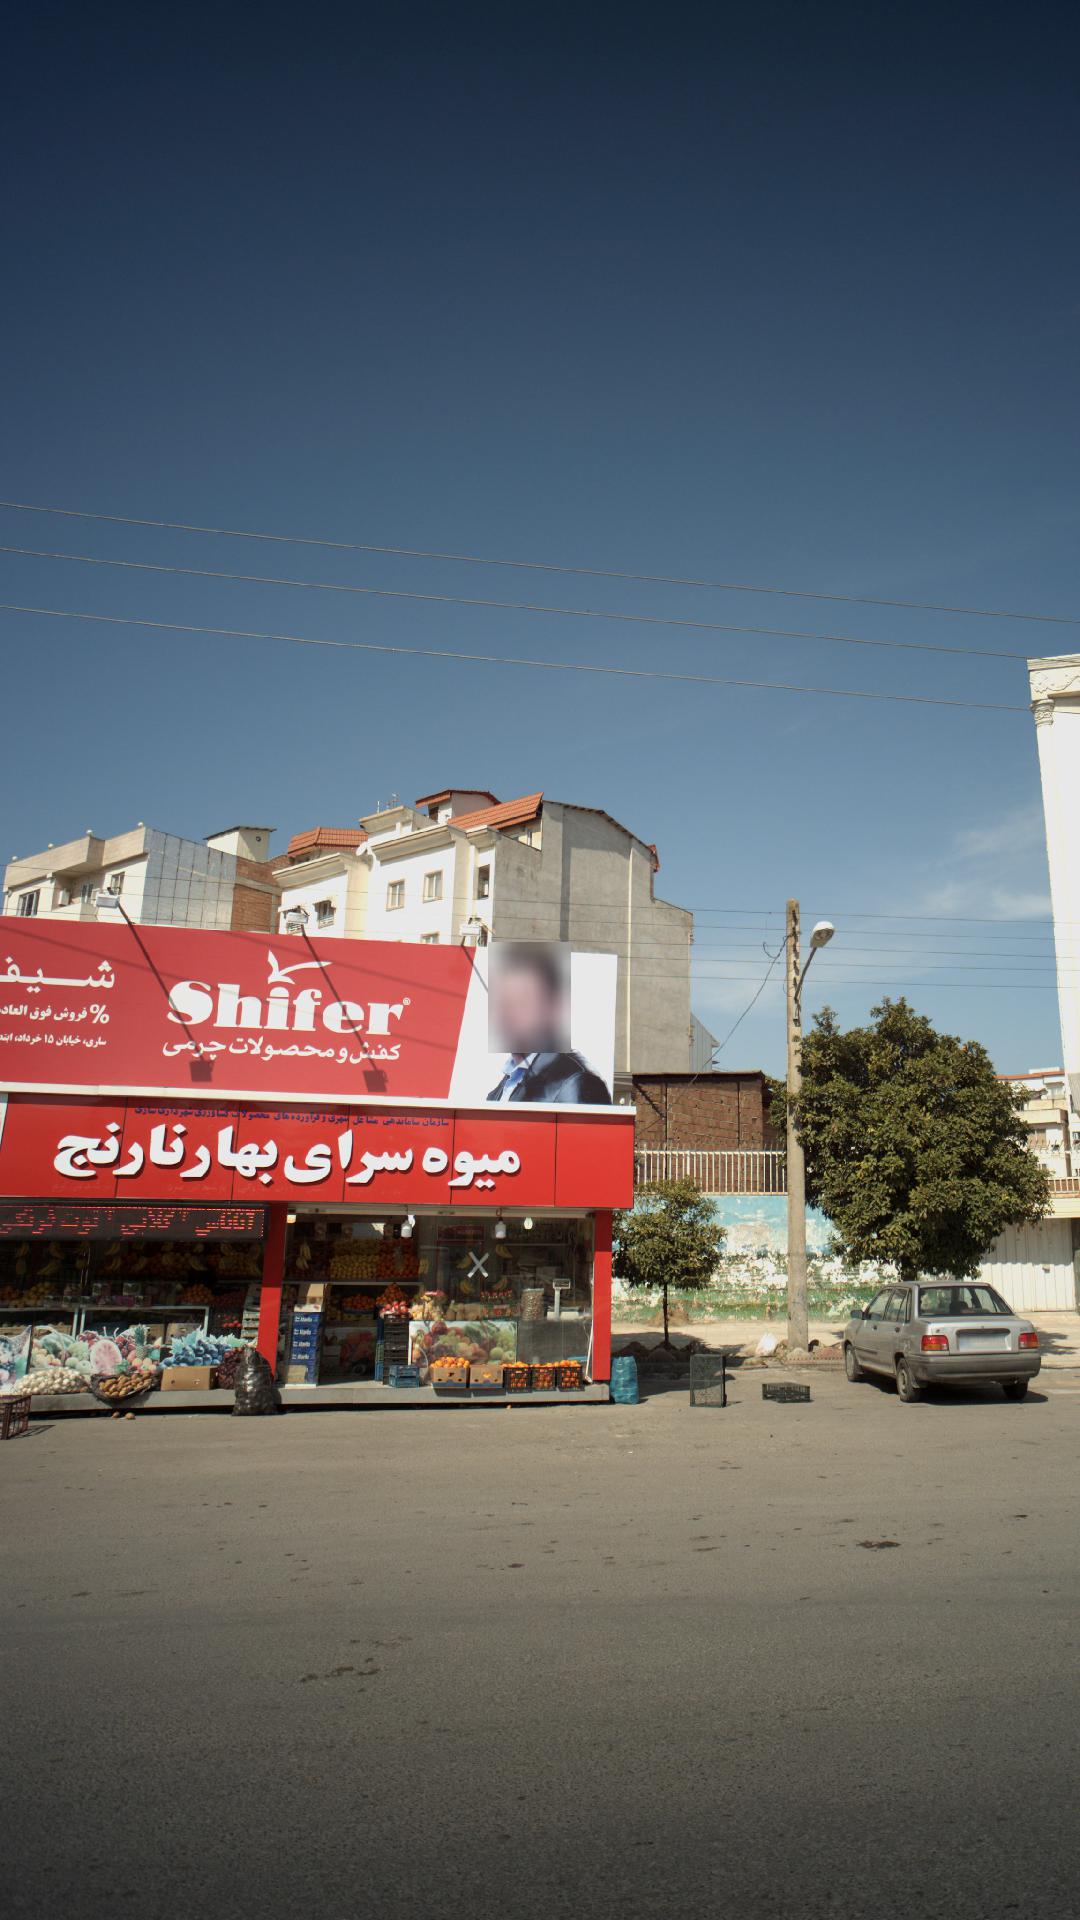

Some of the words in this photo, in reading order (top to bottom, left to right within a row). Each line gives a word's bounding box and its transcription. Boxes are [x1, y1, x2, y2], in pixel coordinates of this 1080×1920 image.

[0, 956, 115, 993] شیف
[29, 1005, 52, 1020] فوق
[53, 1005, 88, 1022] فروش
[165, 980, 404, 1036] Shifer
[55, 1034, 82, 1047] خیابان
[161, 1038, 227, 1061] چرمی
[228, 1036, 335, 1062] محصولات
[349, 1041, 402, 1065] کفش
[283, 1128, 414, 1184] سرای
[421, 1146, 521, 1188] میوه
